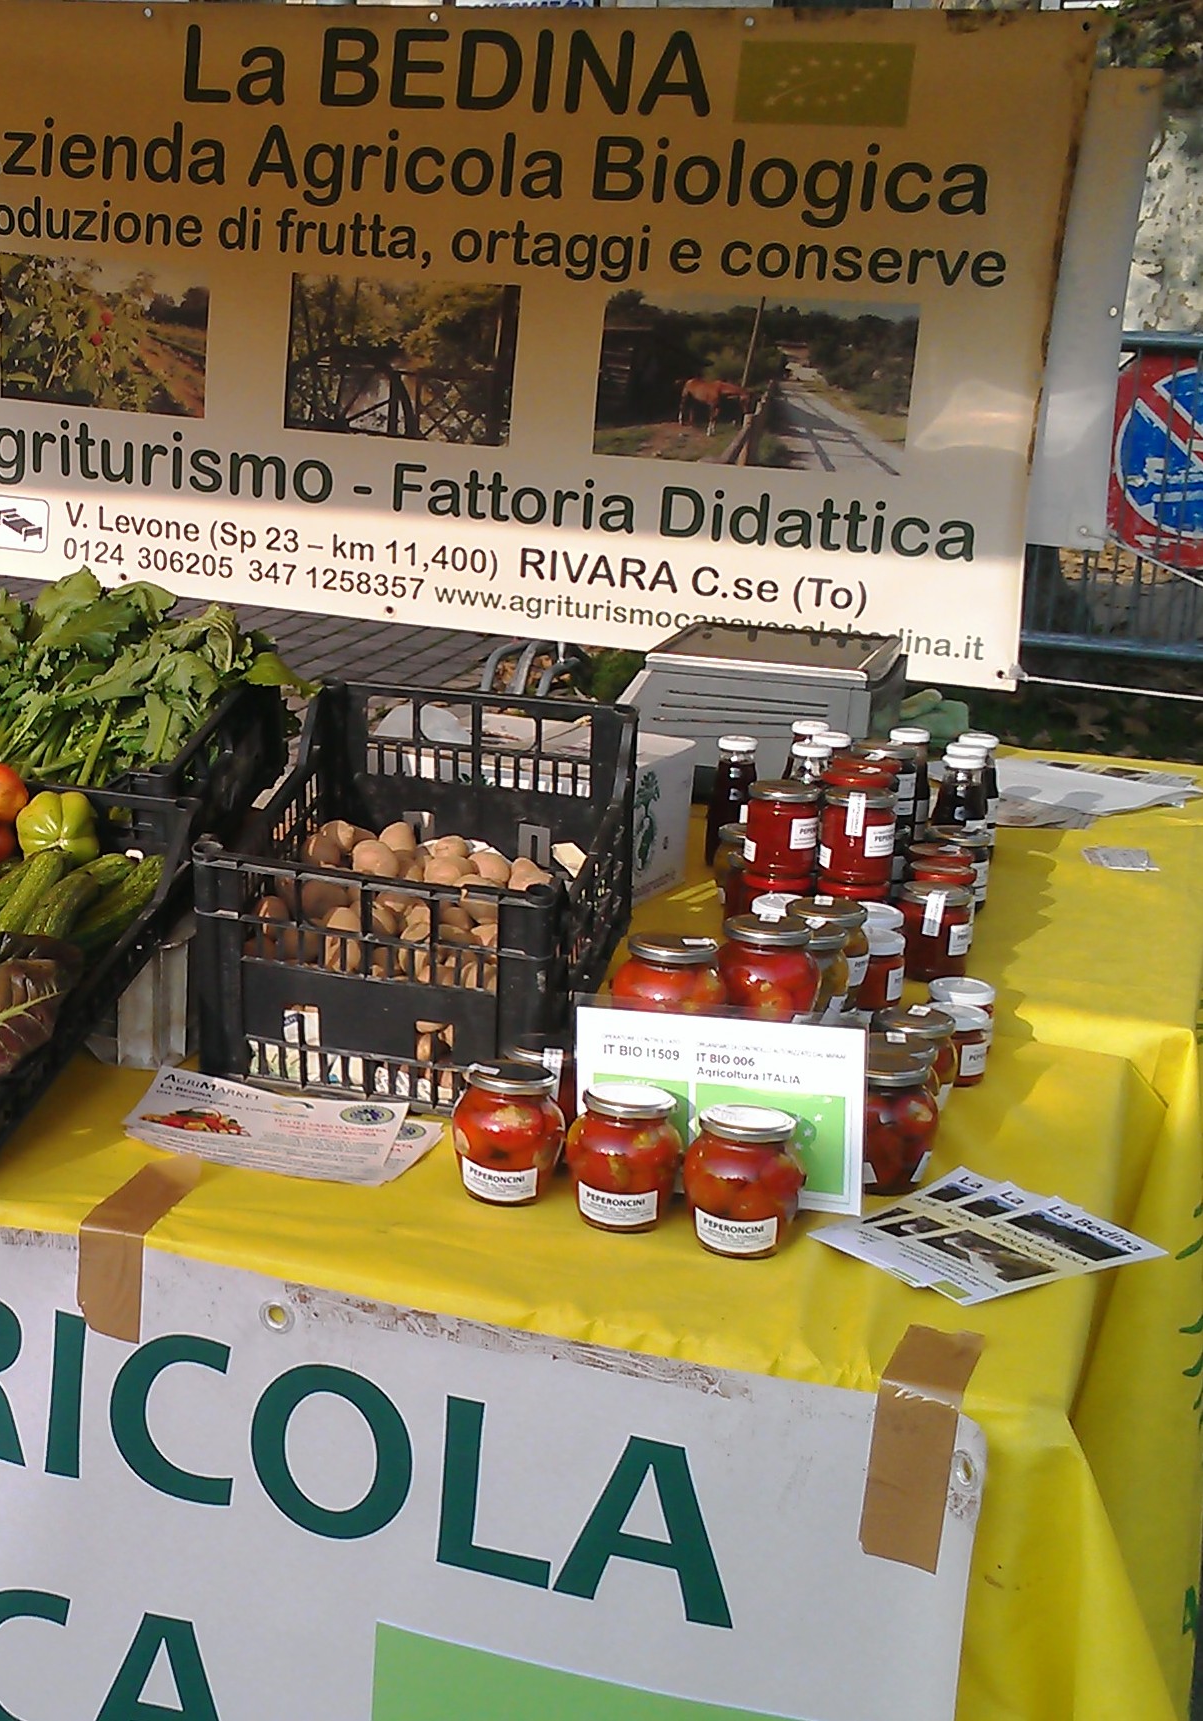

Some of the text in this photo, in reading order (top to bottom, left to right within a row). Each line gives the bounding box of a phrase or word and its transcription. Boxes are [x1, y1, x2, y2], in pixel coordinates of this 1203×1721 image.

[183, 24, 711, 117] La BEDINA
[247, 124, 562, 206] Agricola
[592, 136, 990, 229] Biologica
[218, 205, 261, 252] di
[275, 208, 432, 270] frutta,
[450, 220, 651, 282] ortaggi
[669, 237, 702, 274] e
[720, 238, 1008, 289] conserve
[392, 463, 635, 535] Fattoria
[659, 485, 977, 563] Didattica
[63, 537, 124, 567] 0124
[137, 547, 234, 579] 306205
[248, 560, 297, 587] 347
[305, 565, 426, 601] 1258357
[64, 501, 88, 529] V.
[98, 505, 200, 542] Levone
[209, 519, 256, 555] (Sp
[265, 526, 299, 553] 23
[332, 533, 375, 564] km
[385, 538, 499, 578] 11,400)
[518, 547, 678, 595] RIVARA
[690, 565, 780, 605] C.se
[793, 576, 868, 619] (To)
[603, 1043, 615, 1054] IT
[619, 1045, 643, 1057] BIO
[696, 1052, 756, 1067] IT BIO 006
[696, 1066, 801, 1084] Agricoltura ITALIA
[469, 1166, 526, 1184] PEPERONCINI
[959, 1176, 983, 1189] La
[586, 1191, 646, 1207] PEPERONCINI
[1000, 1191, 1025, 1205] La
[703, 1217, 765, 1234] PEPERONCINI
[1047, 1205, 1143, 1251] La Bedina
